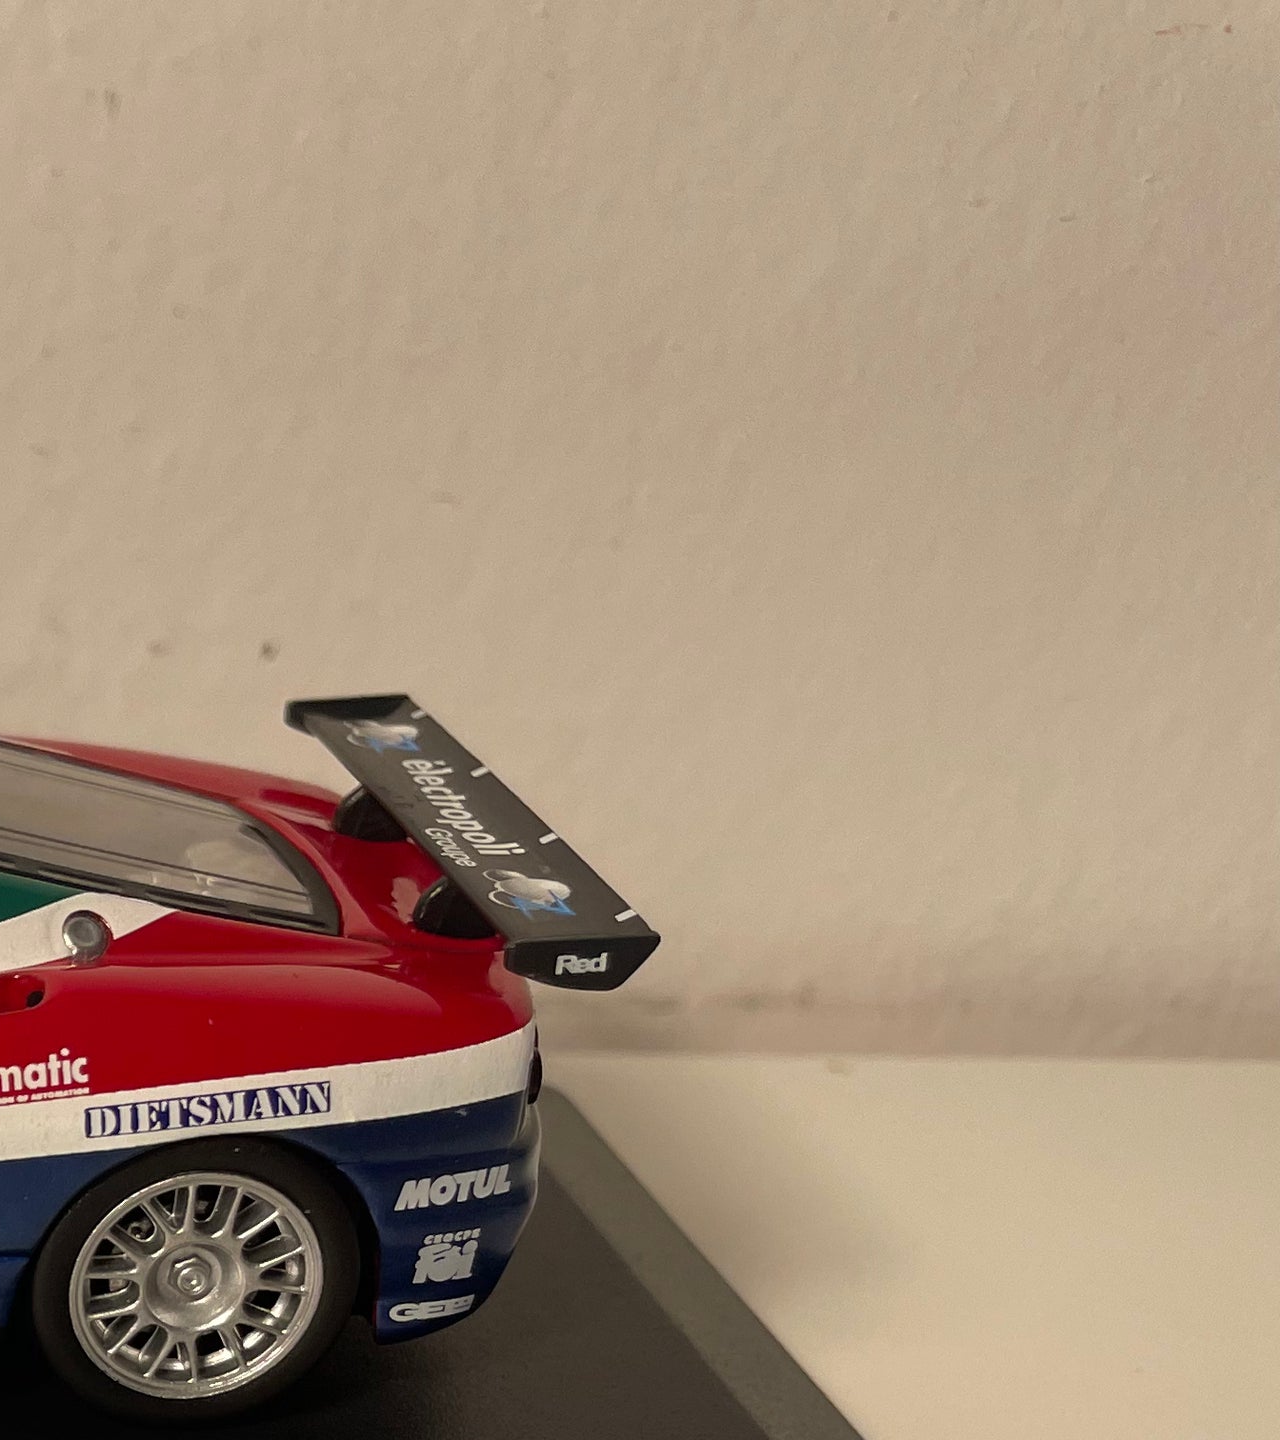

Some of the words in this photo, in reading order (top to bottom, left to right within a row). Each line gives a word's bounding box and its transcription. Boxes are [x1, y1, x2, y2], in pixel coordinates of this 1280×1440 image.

[425, 827, 477, 868] Groupe
[555, 952, 607, 976] Red
[87, 1082, 331, 1138] DIETSMANN
[394, 1164, 511, 1211] MOTUL
